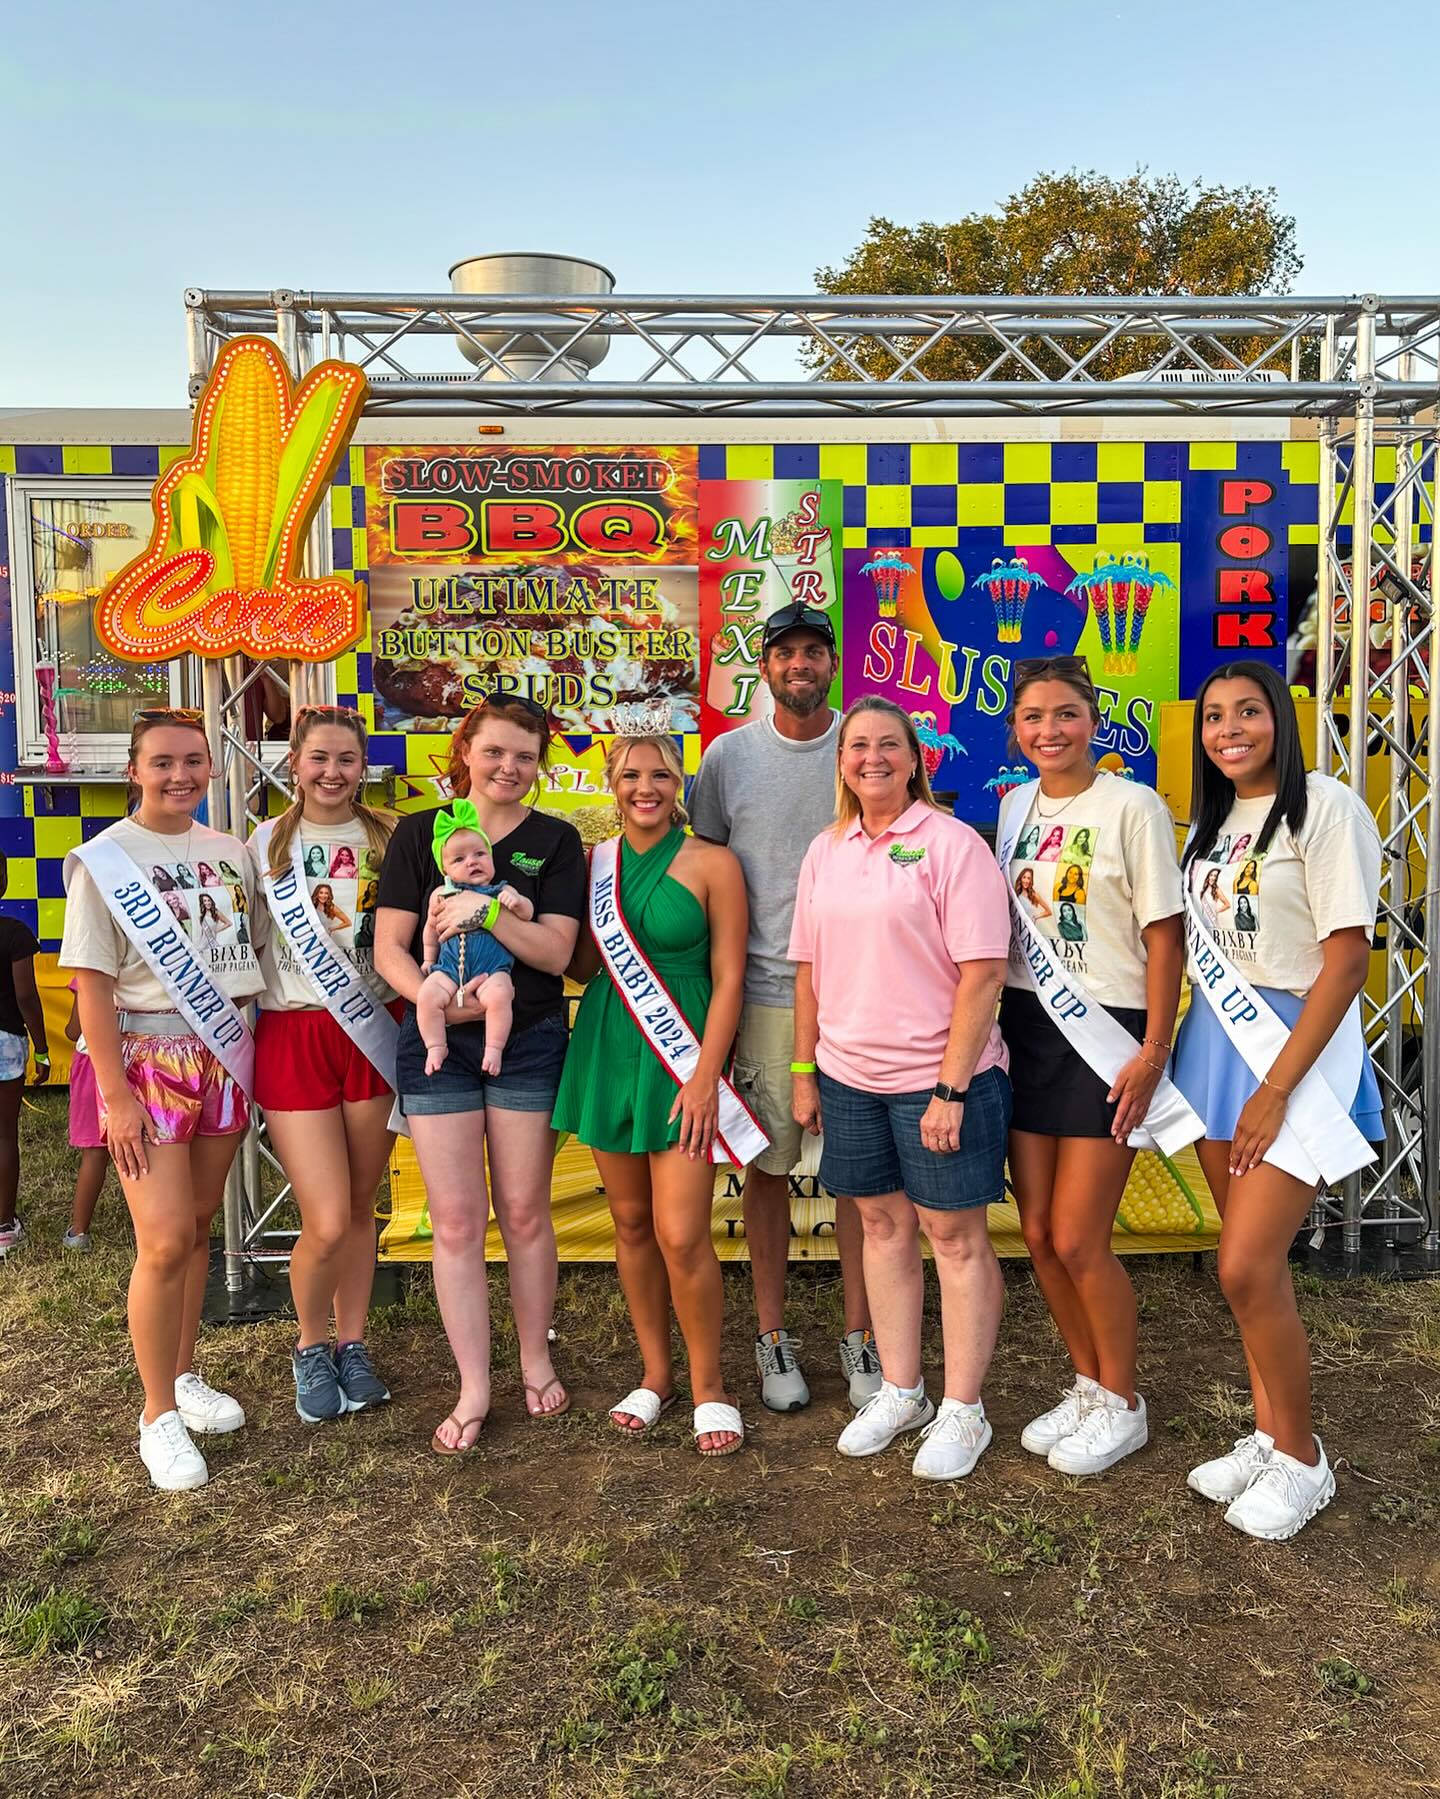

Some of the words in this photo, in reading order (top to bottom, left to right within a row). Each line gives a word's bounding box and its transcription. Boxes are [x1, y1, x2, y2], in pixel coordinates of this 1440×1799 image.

[382, 458, 674, 493] SLOW-SMOKED
[66, 522, 130, 538] ORDER
[390, 499, 668, 560] BBQ
[1214, 478, 1277, 649] PORK
[113, 548, 348, 646] Corn
[409, 577, 662, 614] ULTIMATE
[379, 630, 534, 660] BUTTON
[545, 630, 696, 661] BUSTER
[460, 673, 618, 709] SPUDS
[864, 621, 1156, 756] SLUSES
[272, 866, 298, 901] ND
[594, 872, 614, 928] MISS
[211, 945, 255, 962] BIXB
[281, 902, 350, 997] RUNNER
[1049, 938, 1086, 960] XBY
[1213, 929, 1258, 950] BIXBY
[114, 881, 161, 930] 3RD
[147, 927, 226, 1023] RUNNER
[213, 1014, 243, 1048] UP
[603, 930, 658, 1003] BIXBY
[1186, 914, 1225, 990] NNER
[1221, 985, 1258, 1025] UP
[339, 990, 374, 1024] UP
[1051, 984, 1088, 1021] UP
[644, 1006, 691, 1060] 2024
